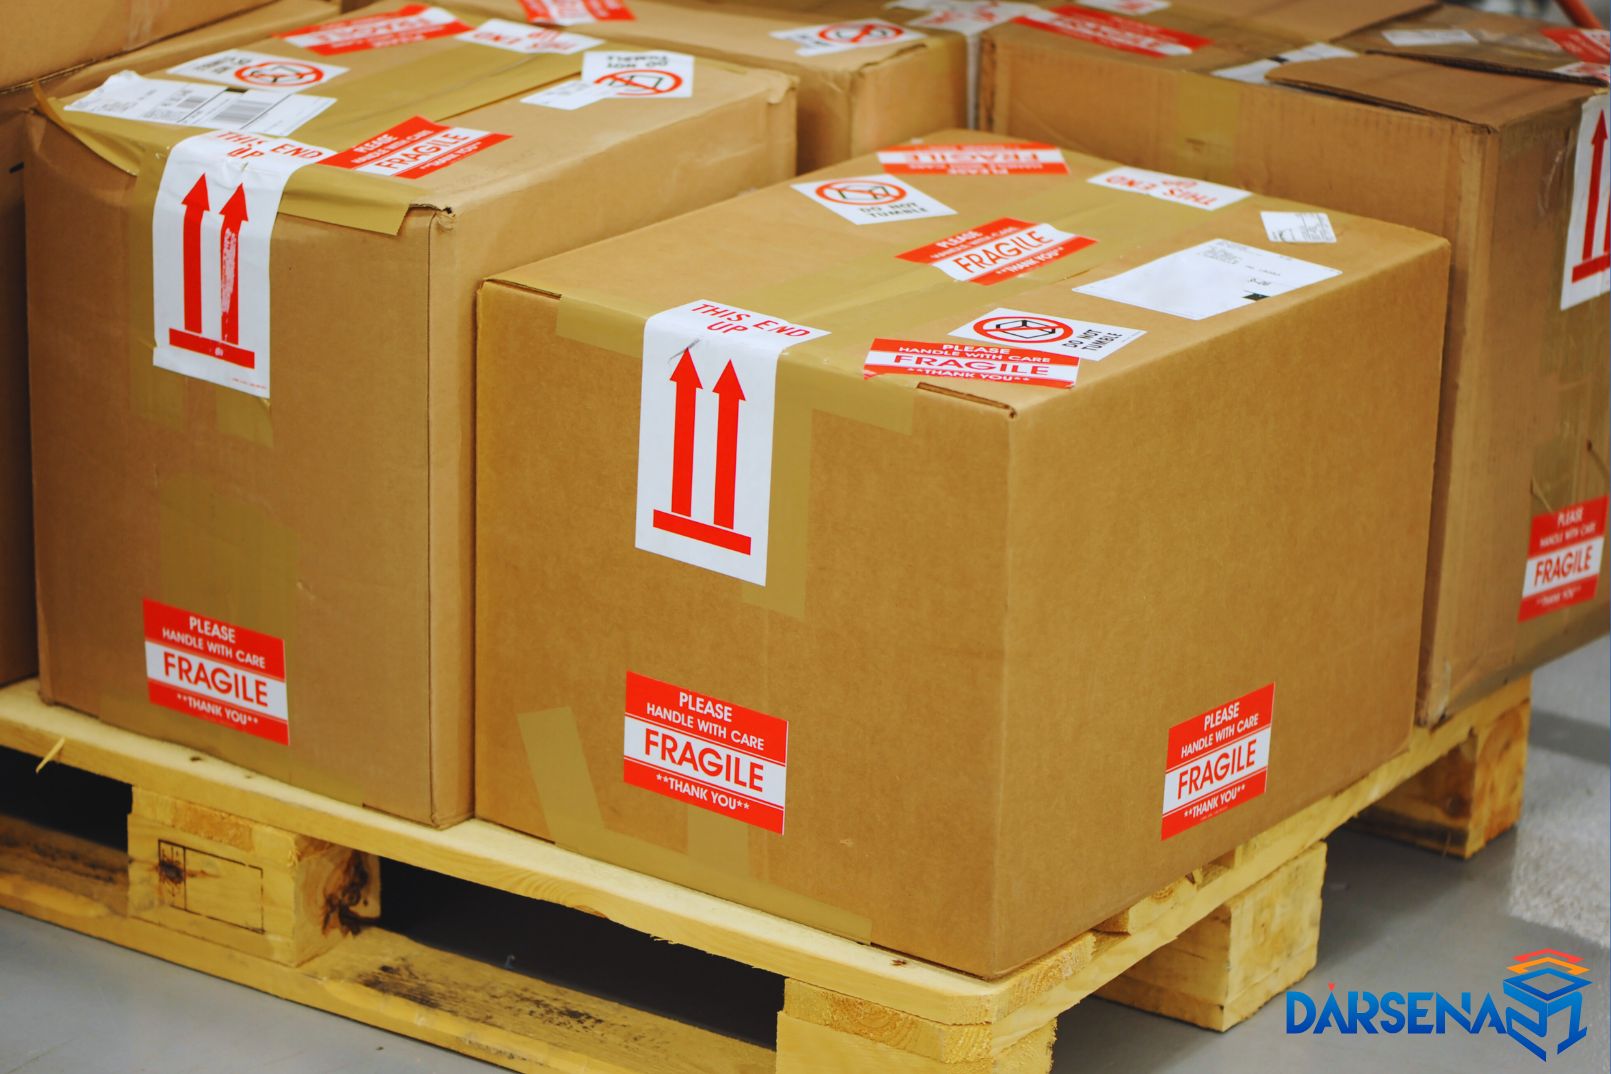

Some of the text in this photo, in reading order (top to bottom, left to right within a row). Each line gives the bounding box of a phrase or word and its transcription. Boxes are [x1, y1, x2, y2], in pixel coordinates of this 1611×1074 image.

[227, 147, 264, 159] UP
[270, 143, 323, 159] END
[353, 134, 398, 153] PLEASE
[374, 133, 469, 170] FRAGILE
[869, 207, 928, 219] TUMBLE
[936, 230, 983, 249] PLEASE
[952, 230, 1053, 274] FRAGILE
[691, 303, 810, 337] THIS END
[707, 321, 749, 334] UP
[942, 344, 1011, 355] PLEASE
[1061, 329, 1102, 348] DO NOT
[1081, 332, 1123, 351] TUMBLE
[894, 354, 1050, 376] FRAGILE
[898, 346, 1051, 363] HANDLE WITH CARE
[1534, 545, 1593, 587] FRAGILE
[189, 616, 236, 644] PLEASE
[162, 627, 266, 669] HANDLE WITH CARE
[163, 651, 268, 707] FRAGILE
[679, 692, 732, 722] PLEASE
[1204, 702, 1240, 731] PLEASE
[646, 703, 764, 751] HANDLE WITH CARE
[1181, 713, 1259, 758] HANDLE WITH CARE
[644, 727, 764, 793] FRAGILE
[1177, 738, 1257, 800] FRAGILE
